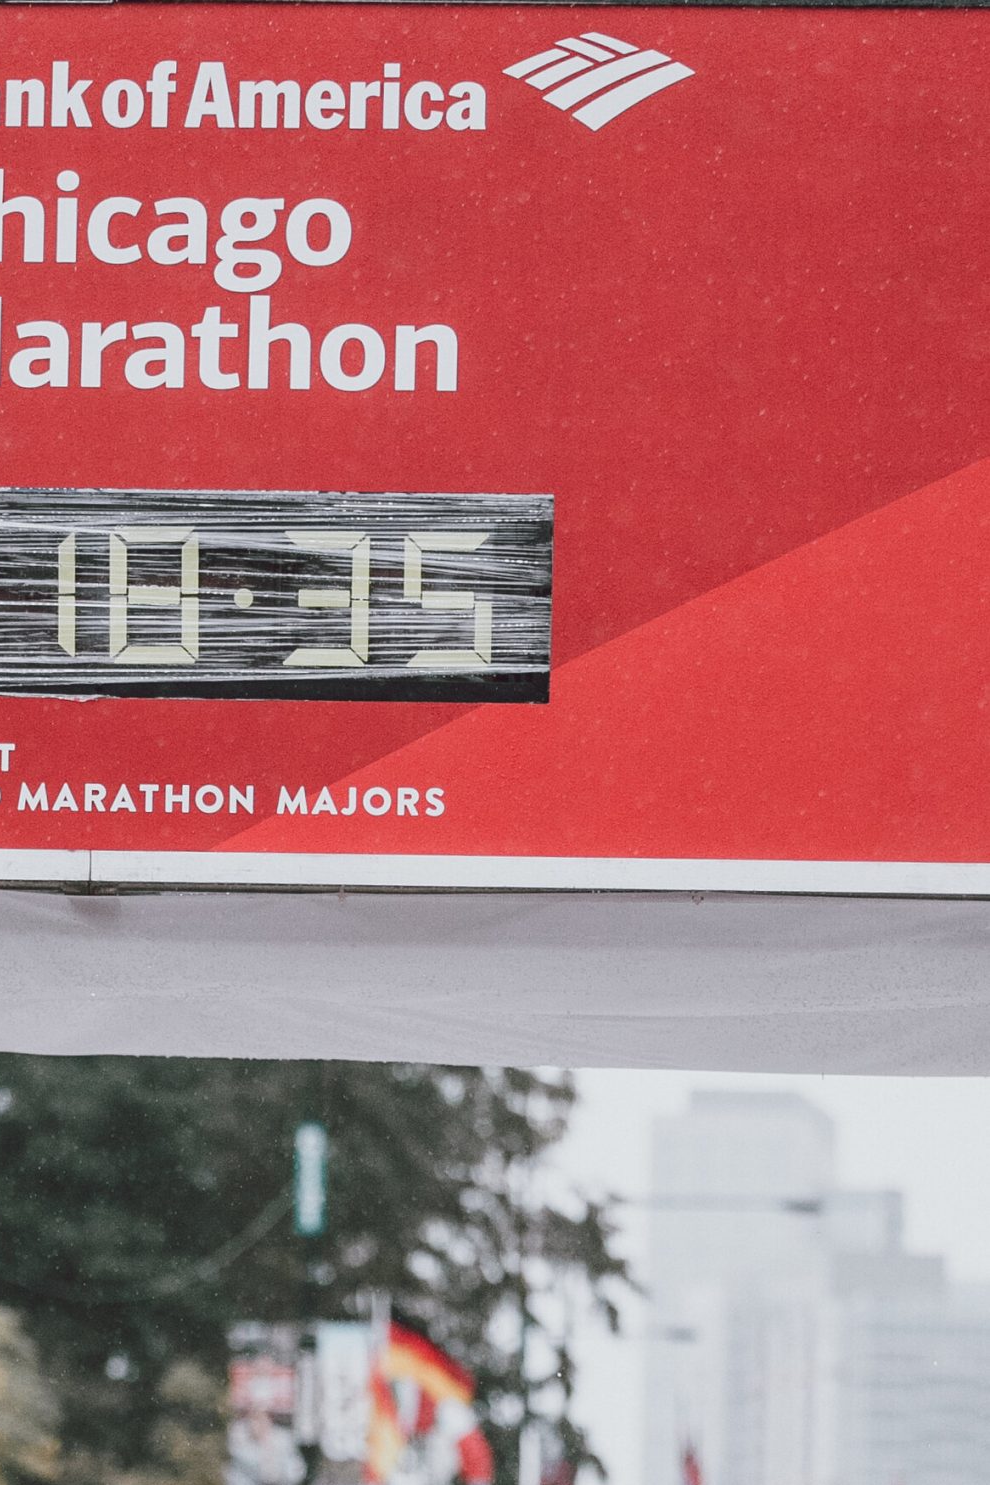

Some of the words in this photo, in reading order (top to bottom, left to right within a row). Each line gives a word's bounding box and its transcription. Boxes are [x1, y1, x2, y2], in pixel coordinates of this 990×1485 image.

[101, 60, 178, 130] of
[183, 62, 487, 132] America
[17, 782, 255, 814] MARATHON
[276, 784, 446, 818] MAJORS
